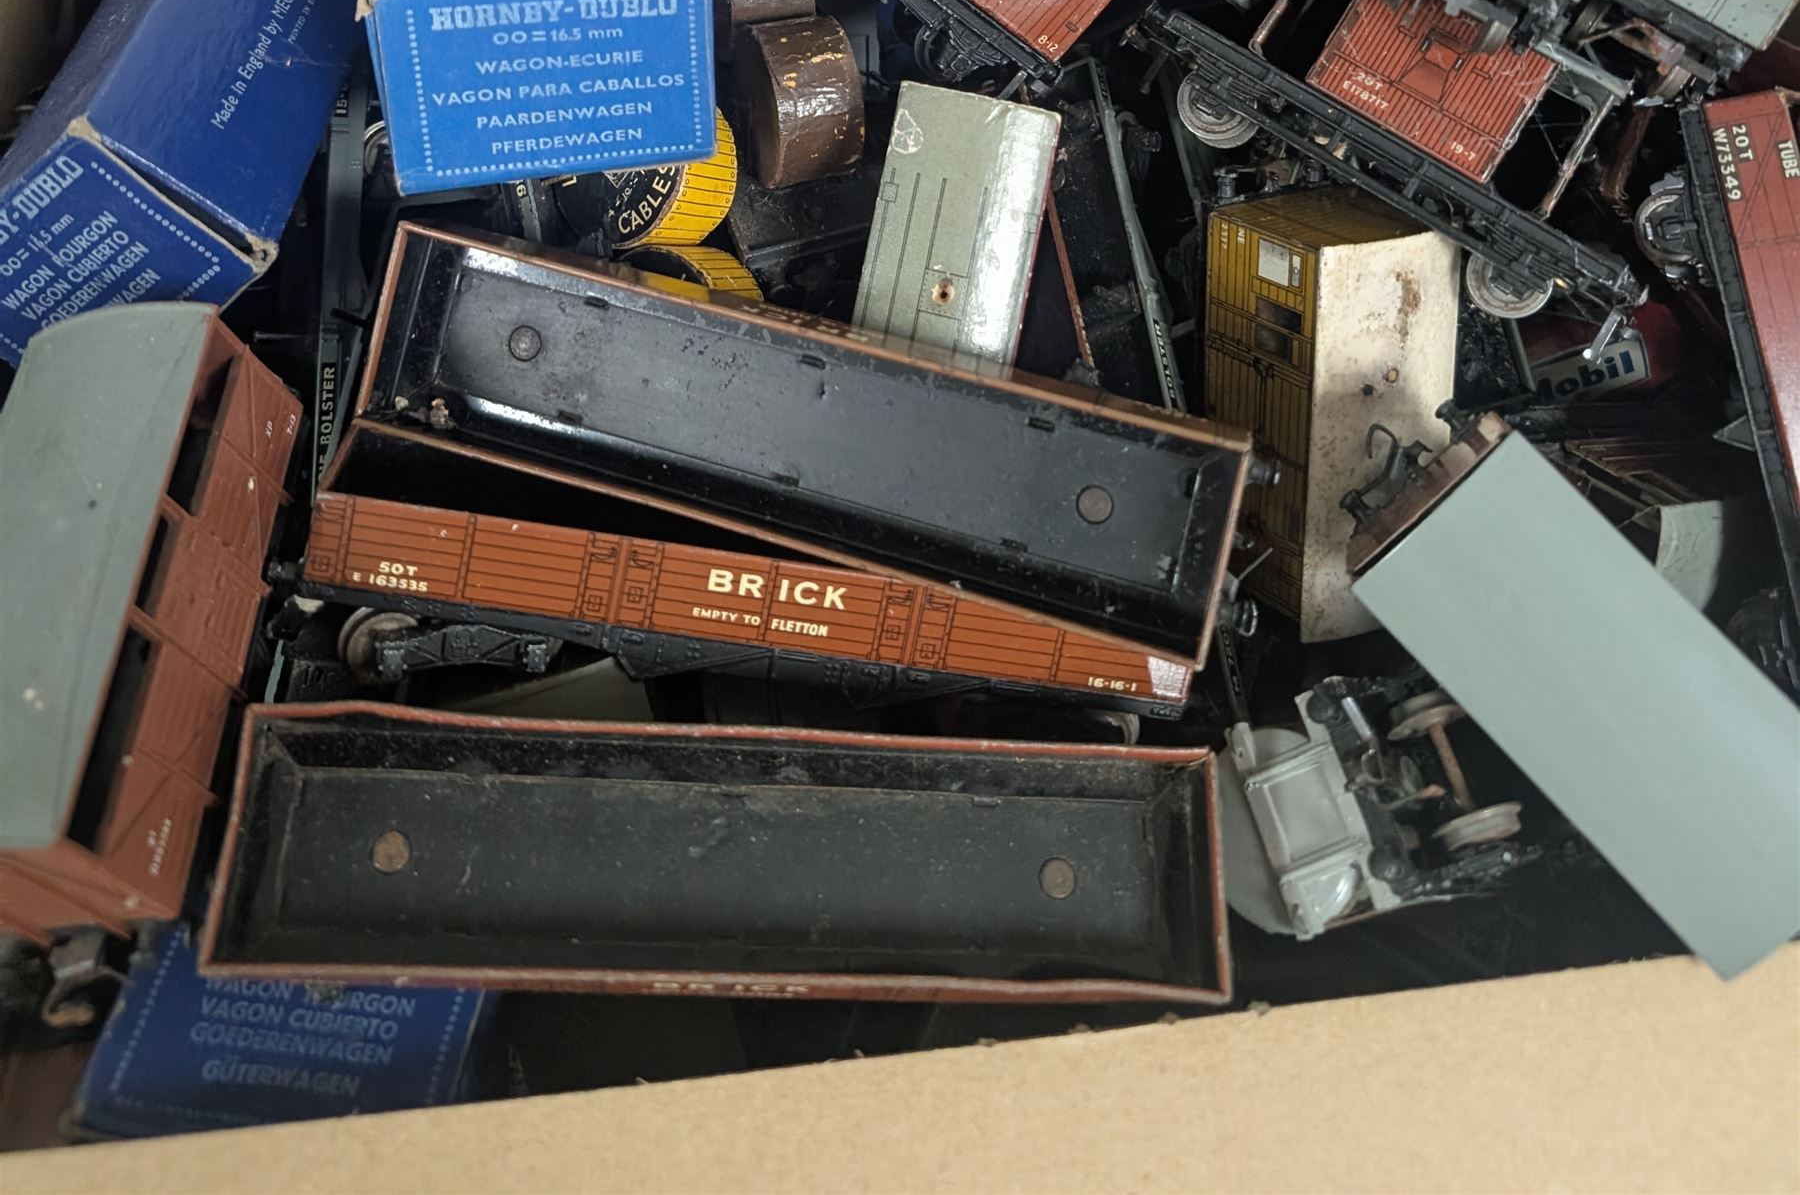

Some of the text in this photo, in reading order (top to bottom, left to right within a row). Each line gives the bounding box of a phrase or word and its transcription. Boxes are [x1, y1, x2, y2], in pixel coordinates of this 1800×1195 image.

[269, 17, 283, 37] by
[288, 14, 307, 45] PRINTED
[588, 27, 624, 39] mm
[238, 33, 272, 81] England
[475, 50, 644, 75] WAGON-ECURIE
[233, 79, 247, 97] in
[432, 74, 685, 106] VAGON PARA CABALLOS
[211, 95, 239, 130] Made
[476, 102, 653, 130] PAARDENWAGEN
[491, 128, 643, 155] PFERDEWAGEN
[1712, 127, 1741, 200] W73349
[1778, 140, 1800, 179] TUBE
[51, 213, 75, 235] mm
[2, 265, 56, 311] WAGON
[20, 230, 130, 322] VAGON CUBIERTO
[1155, 324, 1176, 398] BOLSTER
[320, 367, 335, 445] BOLSTER
[368, 573, 429, 592] 163535
[692, 607, 829, 637] EMPTY TO FLETTON
[204, 978, 294, 1001] WAGON
[200, 995, 400, 1041] VAGON CUBIERTO
[190, 1021, 394, 1065] GOEDERENWAGEN
[201, 1053, 361, 1097] GÜTERWAGEN
